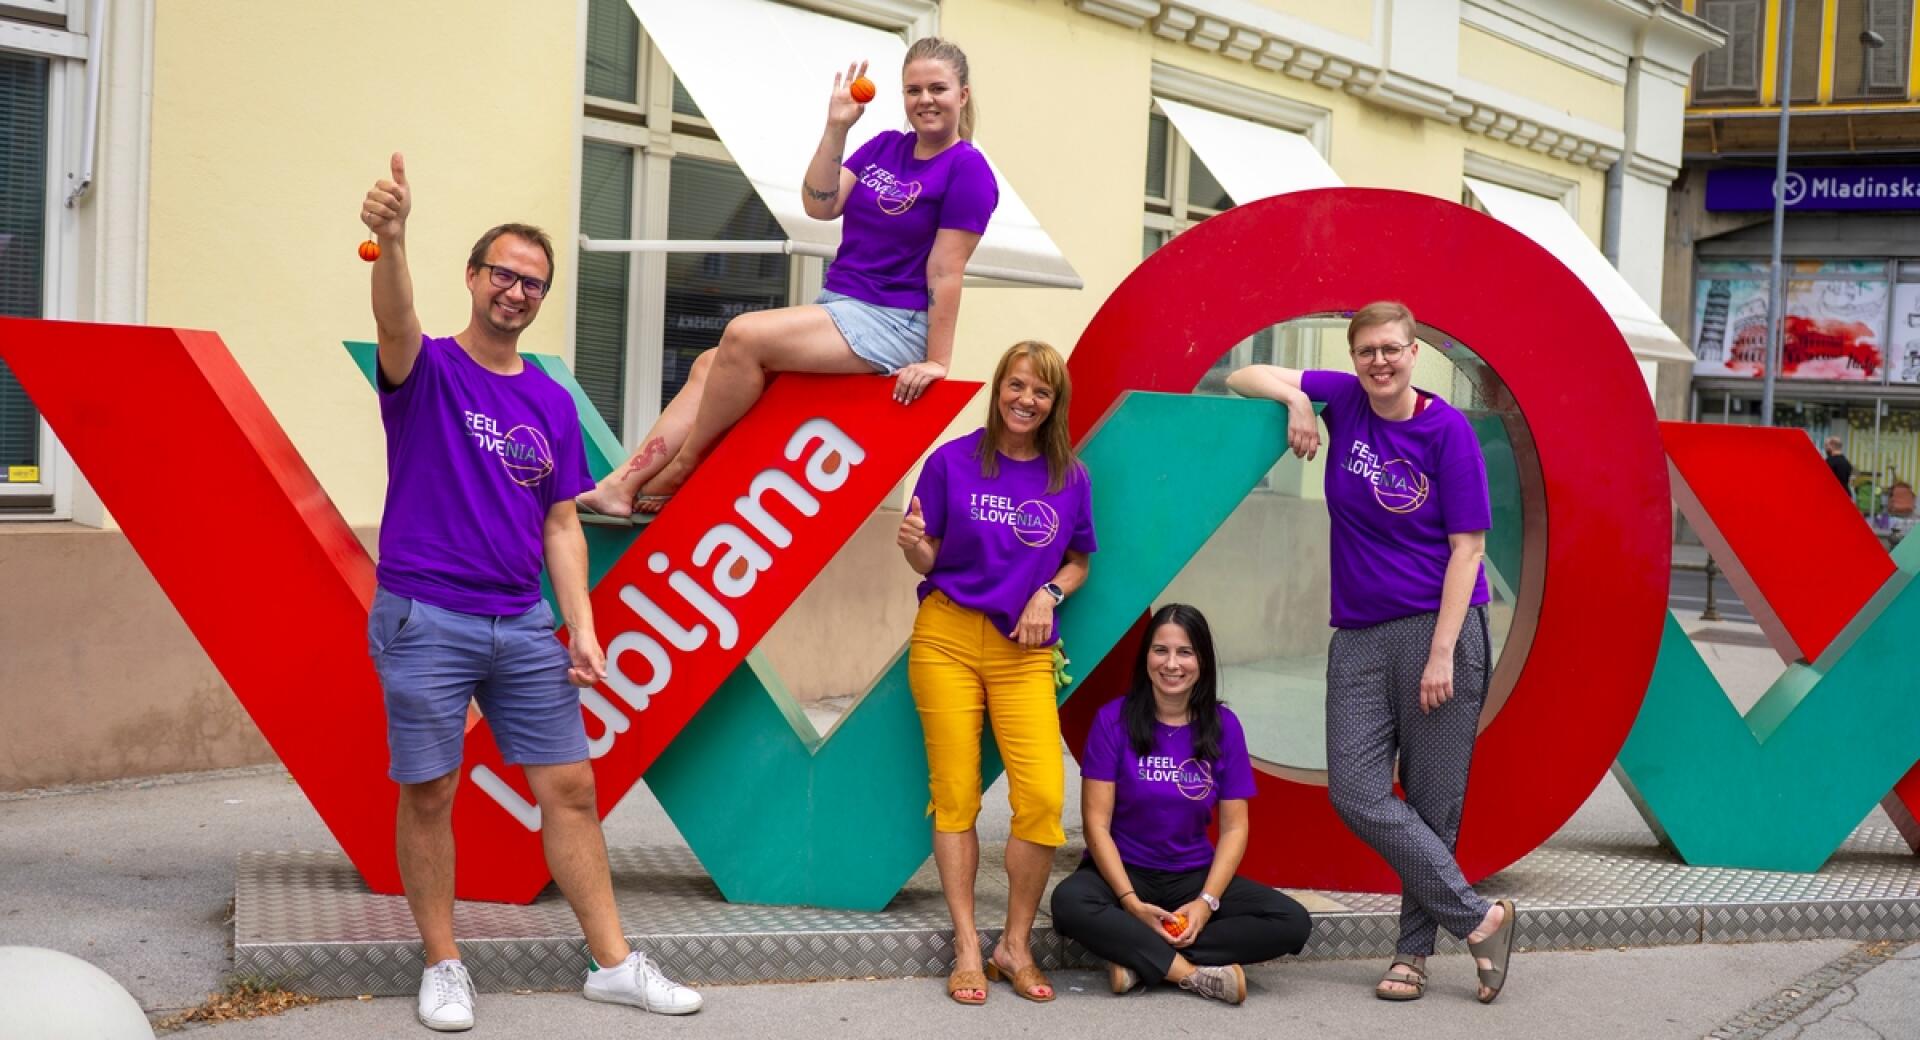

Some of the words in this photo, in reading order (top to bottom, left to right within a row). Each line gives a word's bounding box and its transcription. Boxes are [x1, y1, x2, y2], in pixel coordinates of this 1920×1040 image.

[465, 411, 502, 436] FEEL
[1351, 440, 1381, 469] FEEL
[1341, 457, 1407, 491] LOVENIA
[970, 494, 977, 506] I
[981, 494, 1015, 510] FEEL
[970, 507, 1042, 528] SLOVENIA
[470, 417, 866, 832] Lubljana
[1138, 756, 1144, 767] I
[1147, 756, 1176, 769] FEEL
[1138, 768, 1201, 783] SLOVENIA
